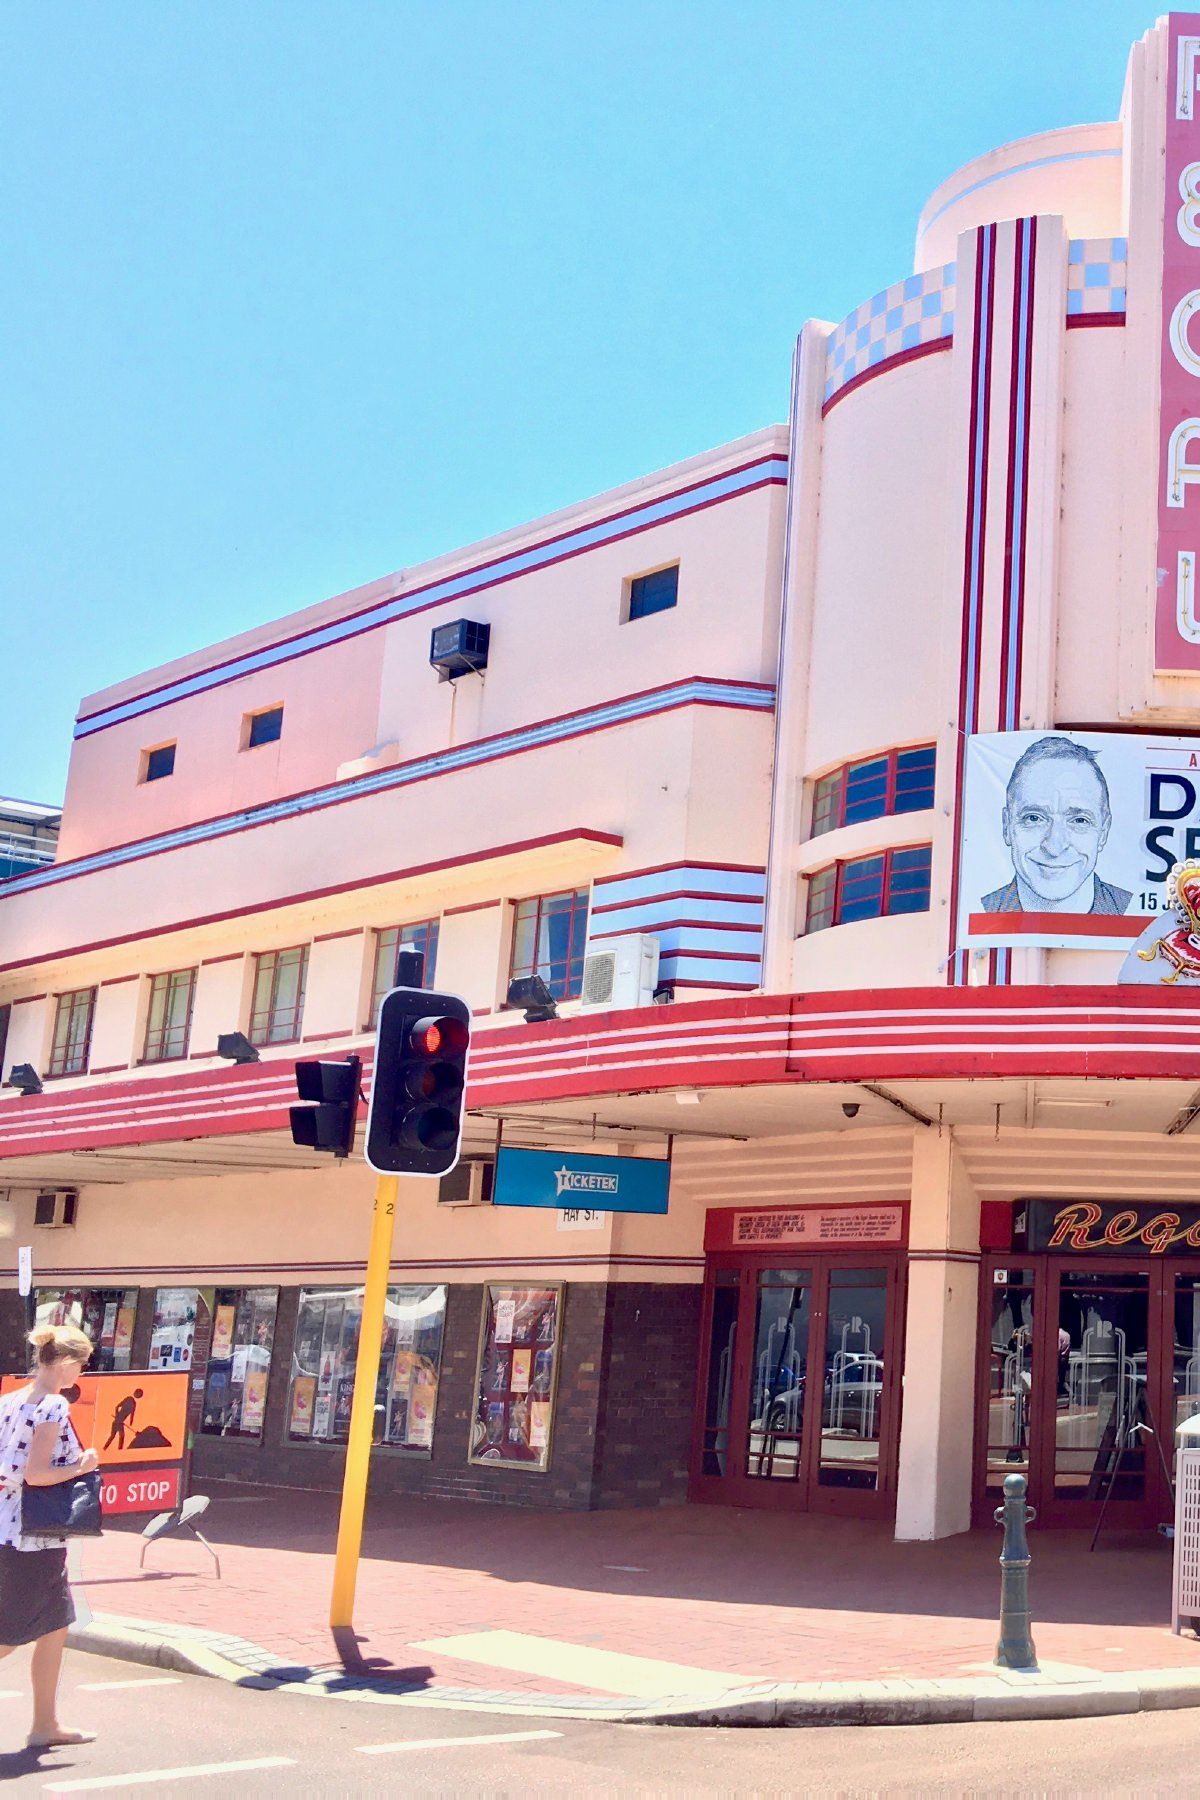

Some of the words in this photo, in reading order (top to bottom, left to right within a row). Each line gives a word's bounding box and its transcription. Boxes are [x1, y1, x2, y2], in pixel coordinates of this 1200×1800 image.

[1139, 892, 1158, 910] 15
[560, 1174, 616, 1190] TICKETEK
[386, 1202, 394, 1215] 2
[563, 1208, 579, 1221] HAY
[126, 1481, 171, 1503] STOP
